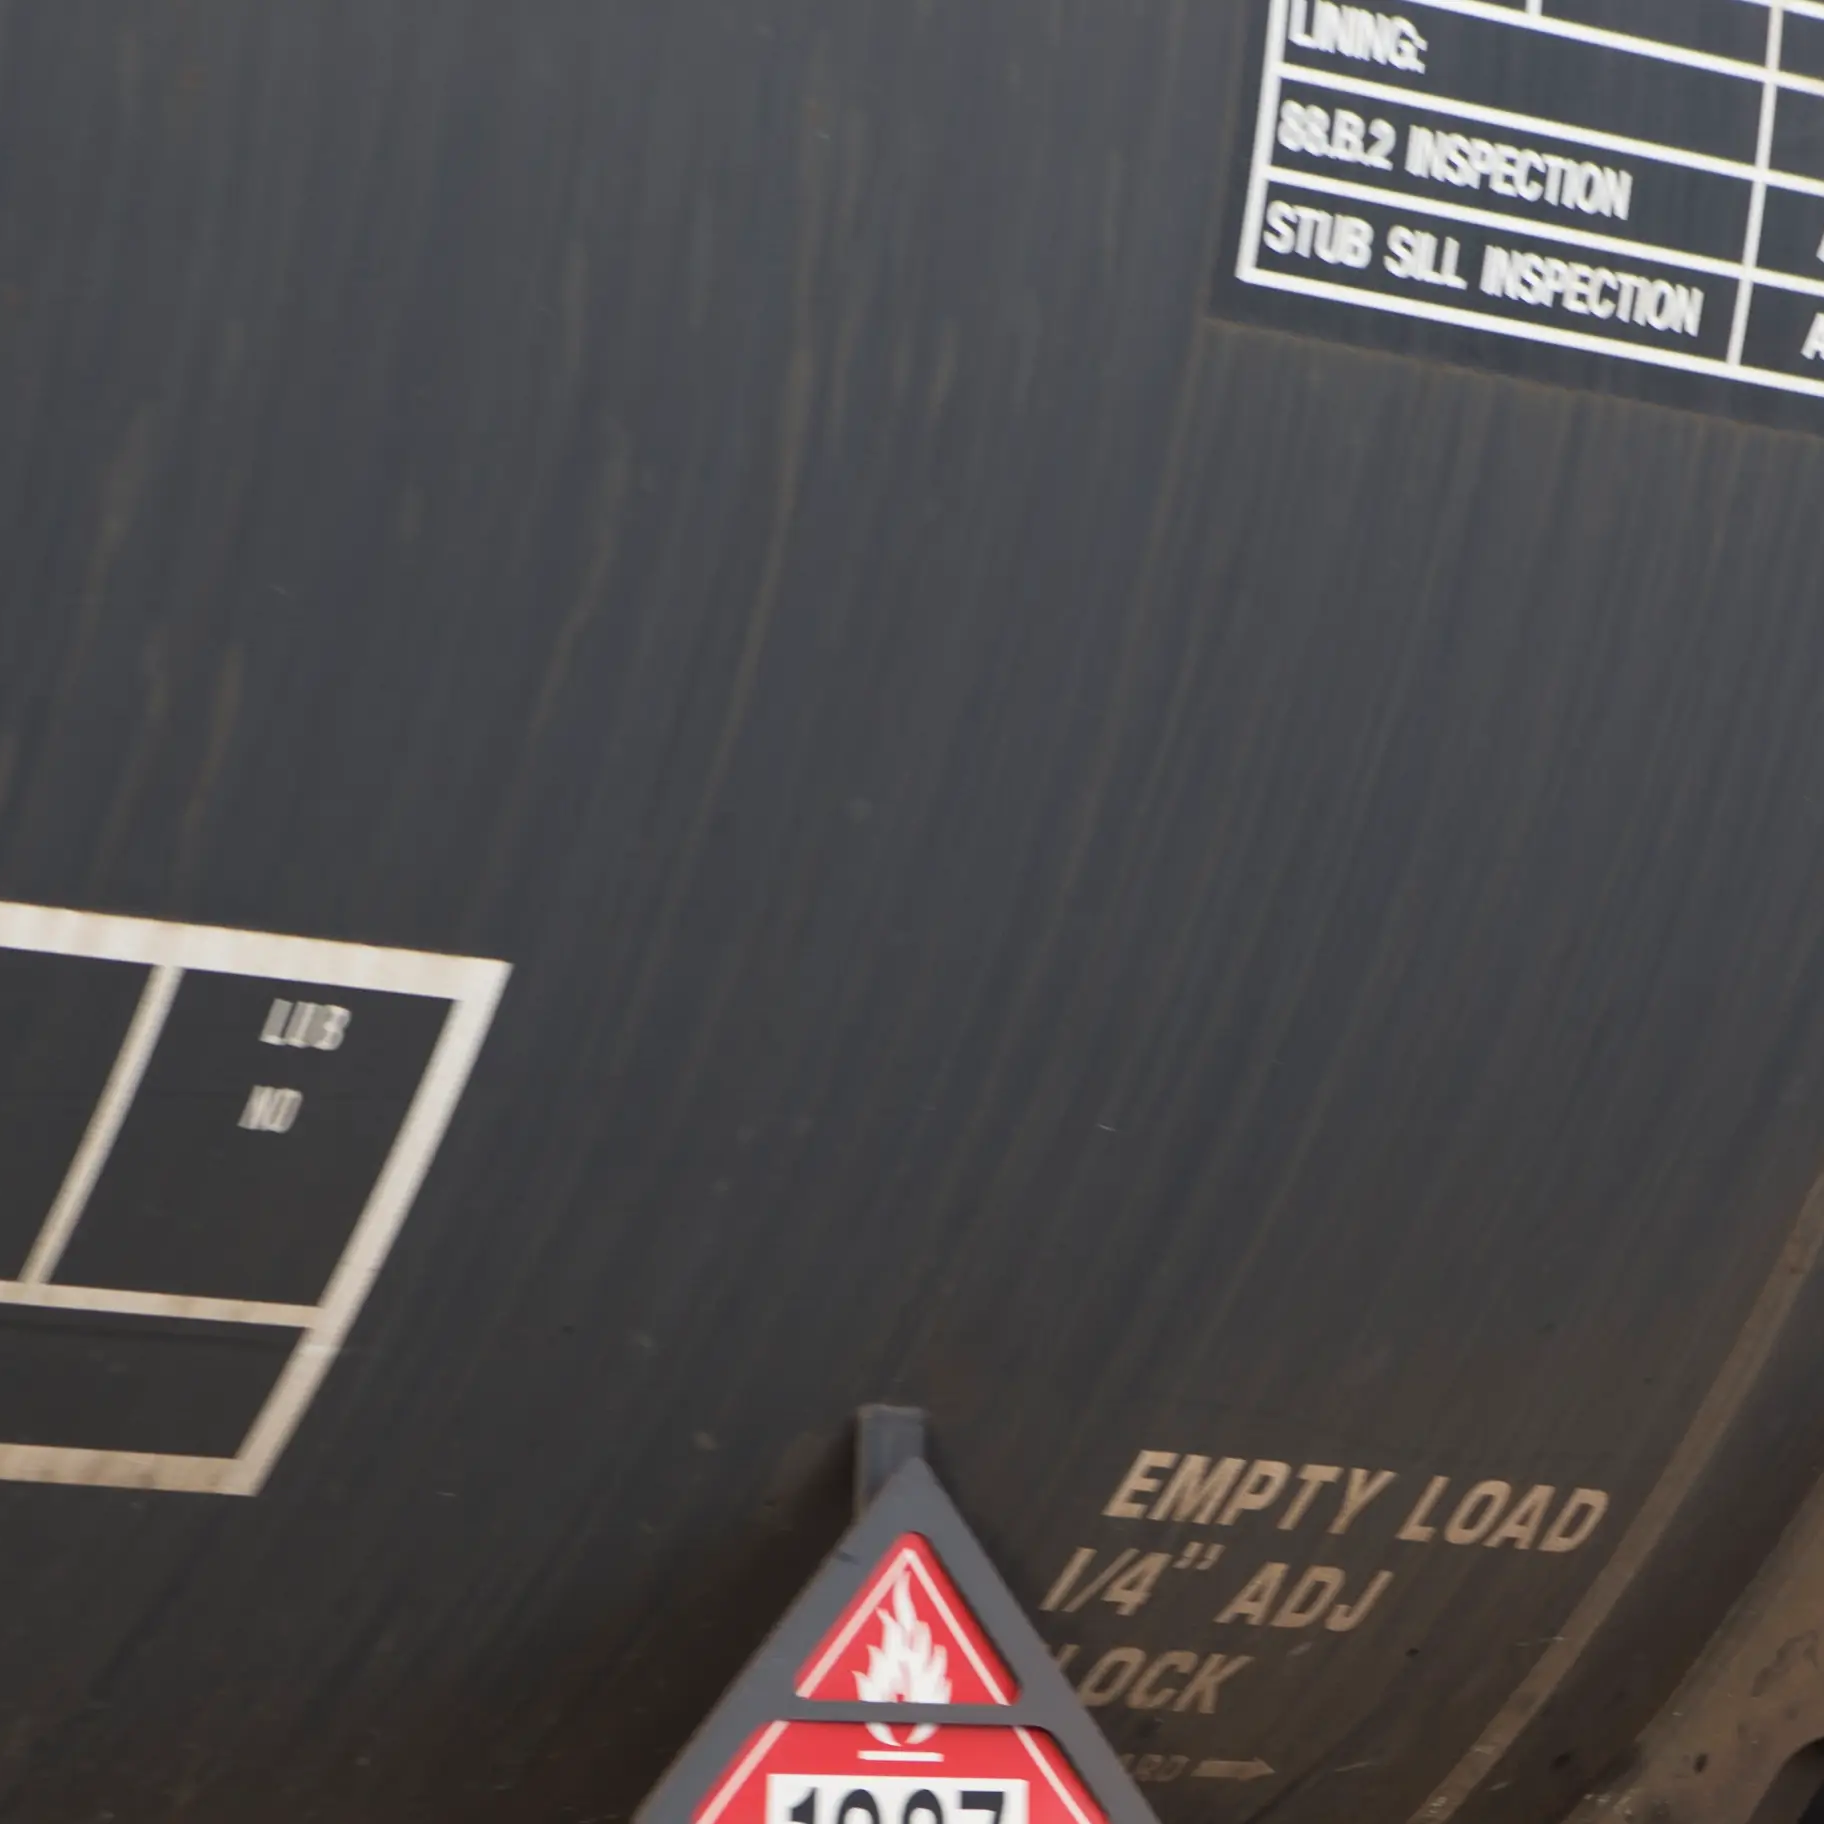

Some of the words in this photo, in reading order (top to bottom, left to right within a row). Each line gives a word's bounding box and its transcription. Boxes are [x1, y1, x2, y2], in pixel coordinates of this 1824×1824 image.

[1405, 123, 1633, 220] INSPECTION
[1263, 200, 1375, 269] STUB
[1383, 224, 1468, 290] SILL
[1479, 243, 1705, 337] INSPECTION
[1104, 1450, 1395, 1536] EMPTY
[1398, 1478, 1610, 1554] LOAD
[1218, 1560, 1394, 1633] ADJ
